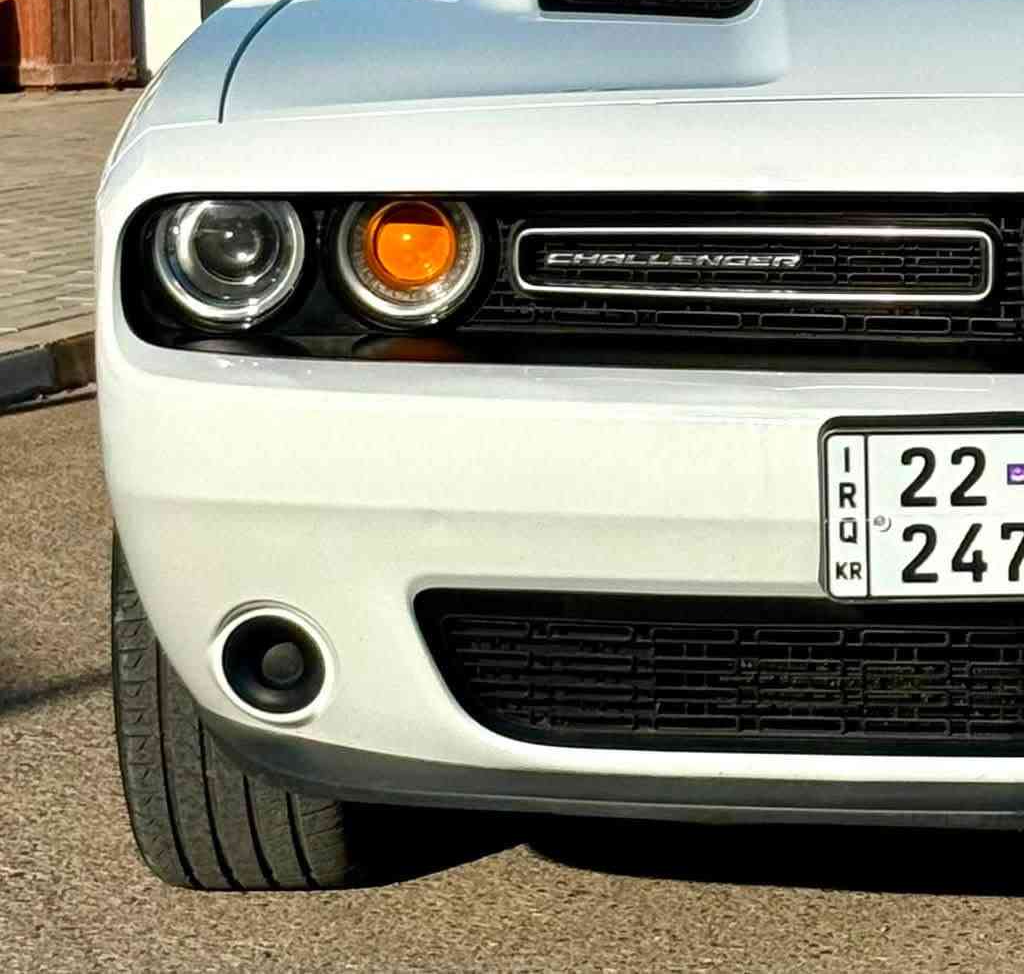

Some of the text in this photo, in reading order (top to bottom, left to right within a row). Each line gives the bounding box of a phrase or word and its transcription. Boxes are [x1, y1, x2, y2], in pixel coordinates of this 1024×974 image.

[545, 252, 801, 268] CHALLENGER
[900, 446, 988, 507] 22
[835, 561, 862, 580] KR
